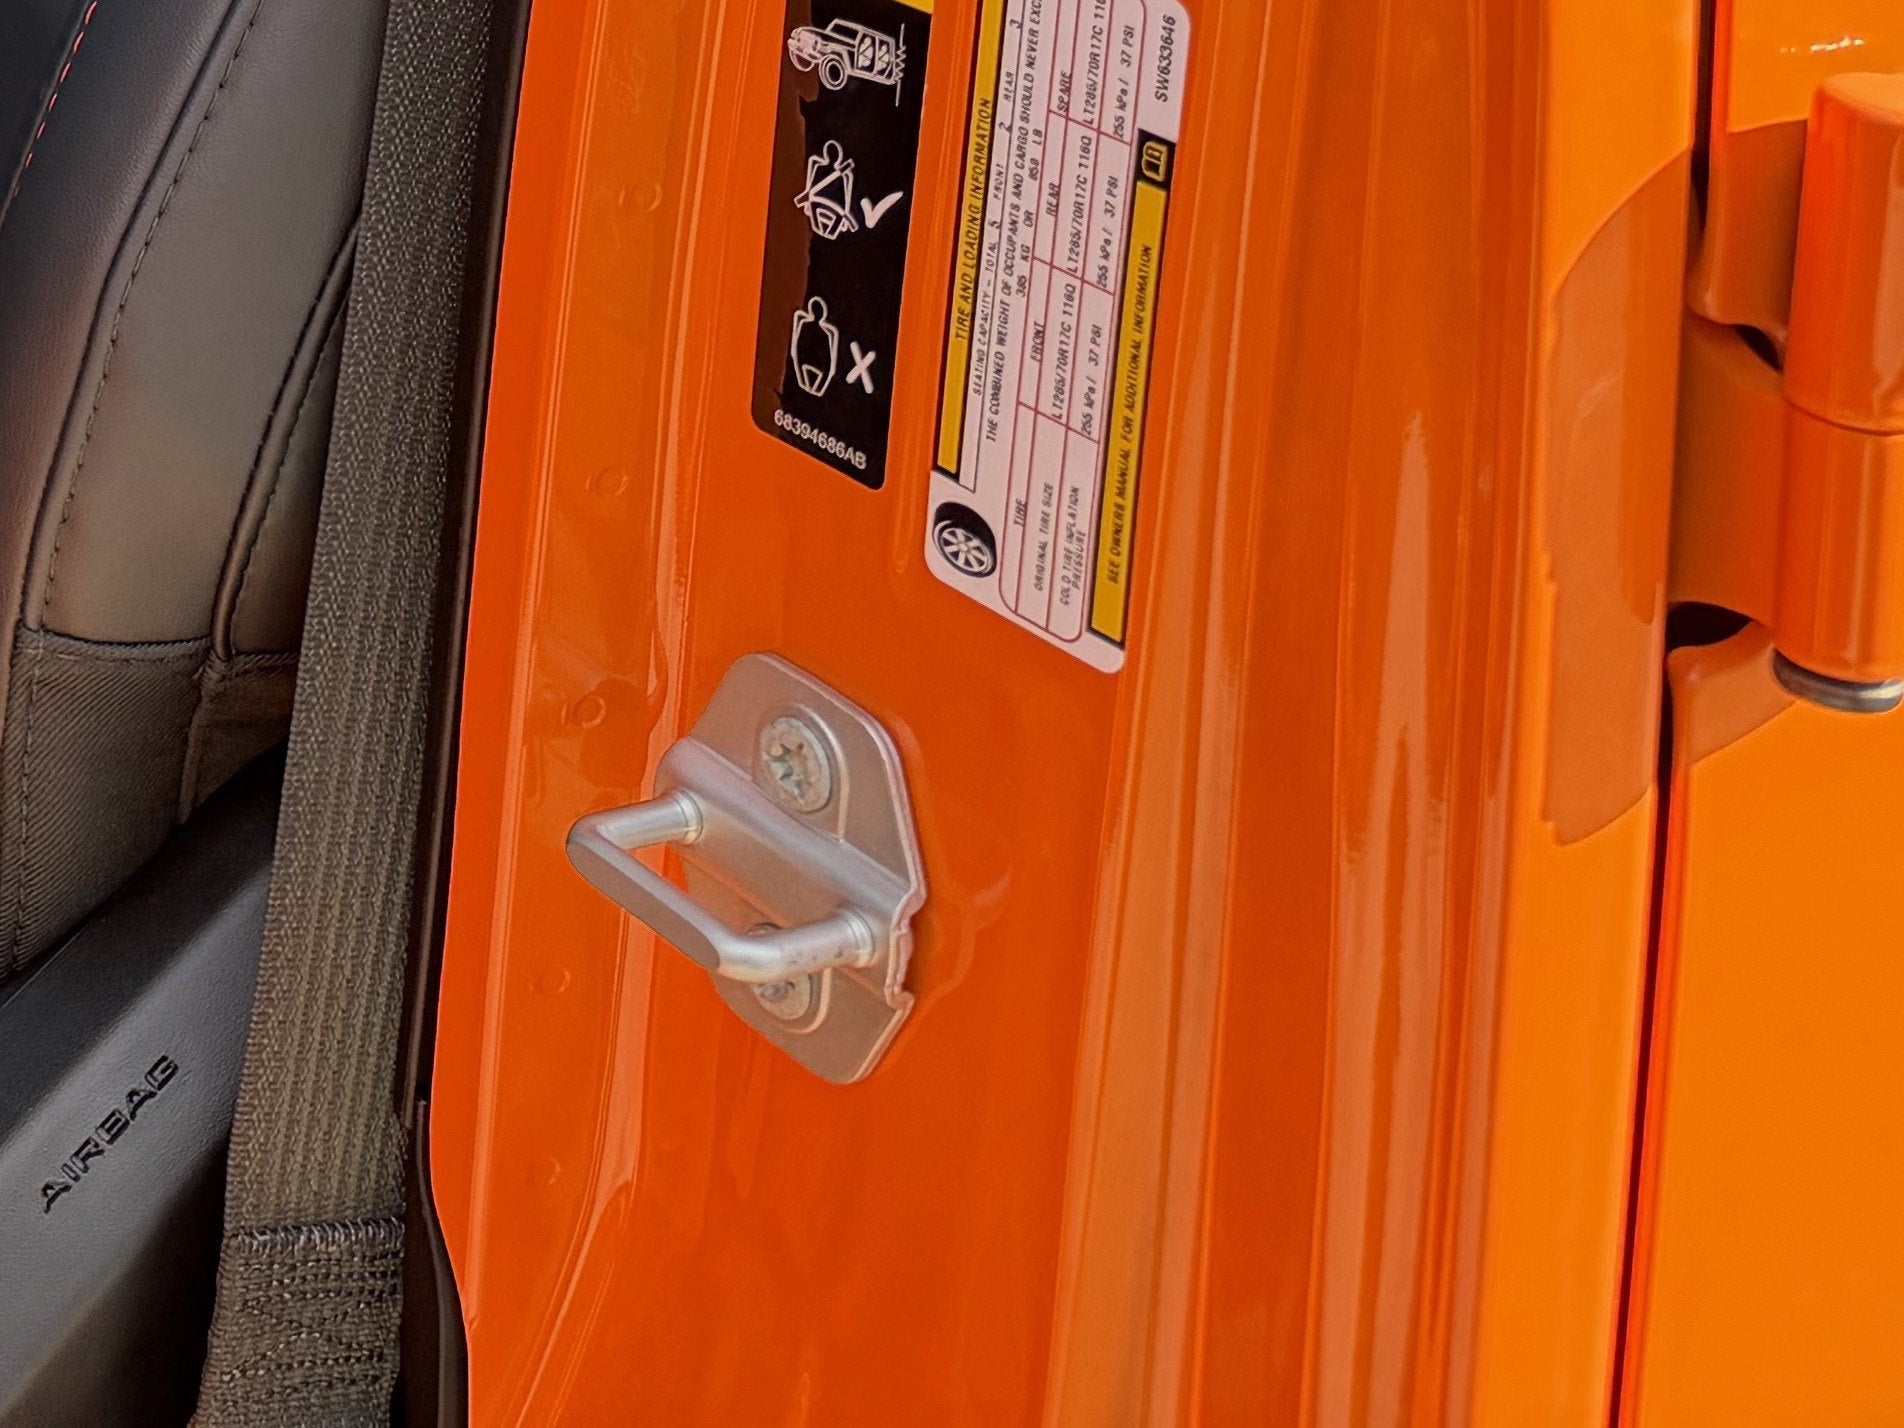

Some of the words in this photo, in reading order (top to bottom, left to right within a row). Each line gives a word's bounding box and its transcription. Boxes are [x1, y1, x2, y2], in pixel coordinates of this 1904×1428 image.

[1024, 27, 1039, 70] NEVER
[1121, 24, 1134, 48] PSI
[1119, 48, 1132, 68] 37
[1153, 13, 1176, 103] SW633646
[1018, 72, 1034, 124] SHOULD
[1056, 69, 1072, 112] SPARE
[1031, 127, 1043, 146] LB
[1109, 114, 1125, 140] 255
[968, 97, 991, 201] INFORMATION
[1013, 125, 1029, 170] CARGO
[1011, 172, 1024, 200] AND
[1046, 182, 1060, 218] REAR
[1105, 174, 1118, 198] PSI
[1022, 209, 1036, 230] OR
[1102, 199, 1115, 218] 37
[961, 202, 982, 272] LOADING
[1002, 201, 1021, 277] OCCUPANTS
[1019, 243, 1033, 265] KG
[984, 241, 998, 276] TOTAL
[958, 271, 975, 307] AND
[1000, 278, 1012, 296] OF
[1095, 264, 1108, 289] 255
[1132, 243, 1152, 334] INFORMATION
[955, 307, 971, 341] TIRE
[976, 291, 991, 347] CAPACITY
[995, 298, 1010, 346] WEIGHT
[1089, 323, 1102, 347] PSI
[1030, 320, 1045, 363] FRONT
[1087, 347, 1099, 367] 37
[973, 347, 985, 396] SEATING
[988, 350, 1005, 415] COMBINED
[1123, 338, 1142, 413] ADDITIONAL
[773, 408, 868, 470] 68394686AB
[985, 417, 998, 442] THE
[1080, 412, 1093, 436] 255
[1119, 415, 1133, 443] FOR
[1114, 448, 1131, 500] MANUAL
[1041, 481, 1054, 508] SIZE
[1013, 497, 1028, 528] TIRE
[1038, 509, 1050, 535] TIRE
[1065, 485, 1079, 544] INFLATION
[1109, 501, 1125, 557] OWNERS
[1033, 540, 1048, 591] ORIGINAL
[1061, 546, 1075, 571] TIRE
[1071, 530, 1086, 589] PRESSURE
[1106, 559, 1120, 584] SEE
[1058, 574, 1072, 606] COLD
[40, 1054, 180, 1215] AIRBAG
